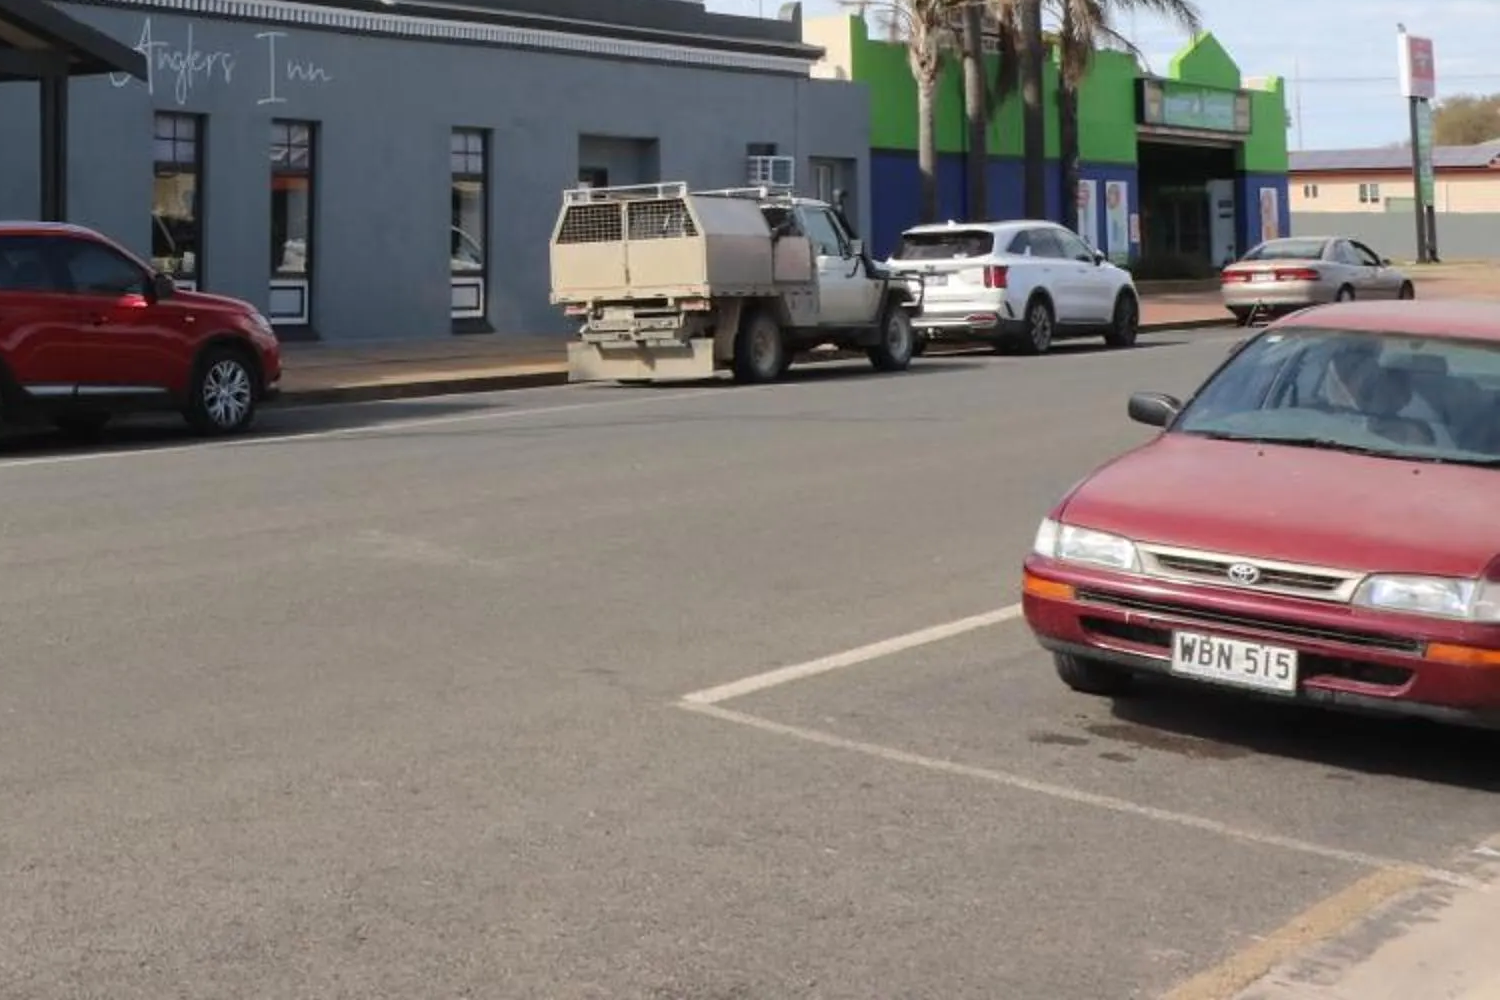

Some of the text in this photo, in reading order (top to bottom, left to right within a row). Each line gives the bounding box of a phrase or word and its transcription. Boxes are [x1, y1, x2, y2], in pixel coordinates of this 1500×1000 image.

[109, 17, 333, 105] Anglers Inn
[1179, 636, 1292, 680] WBN 515
